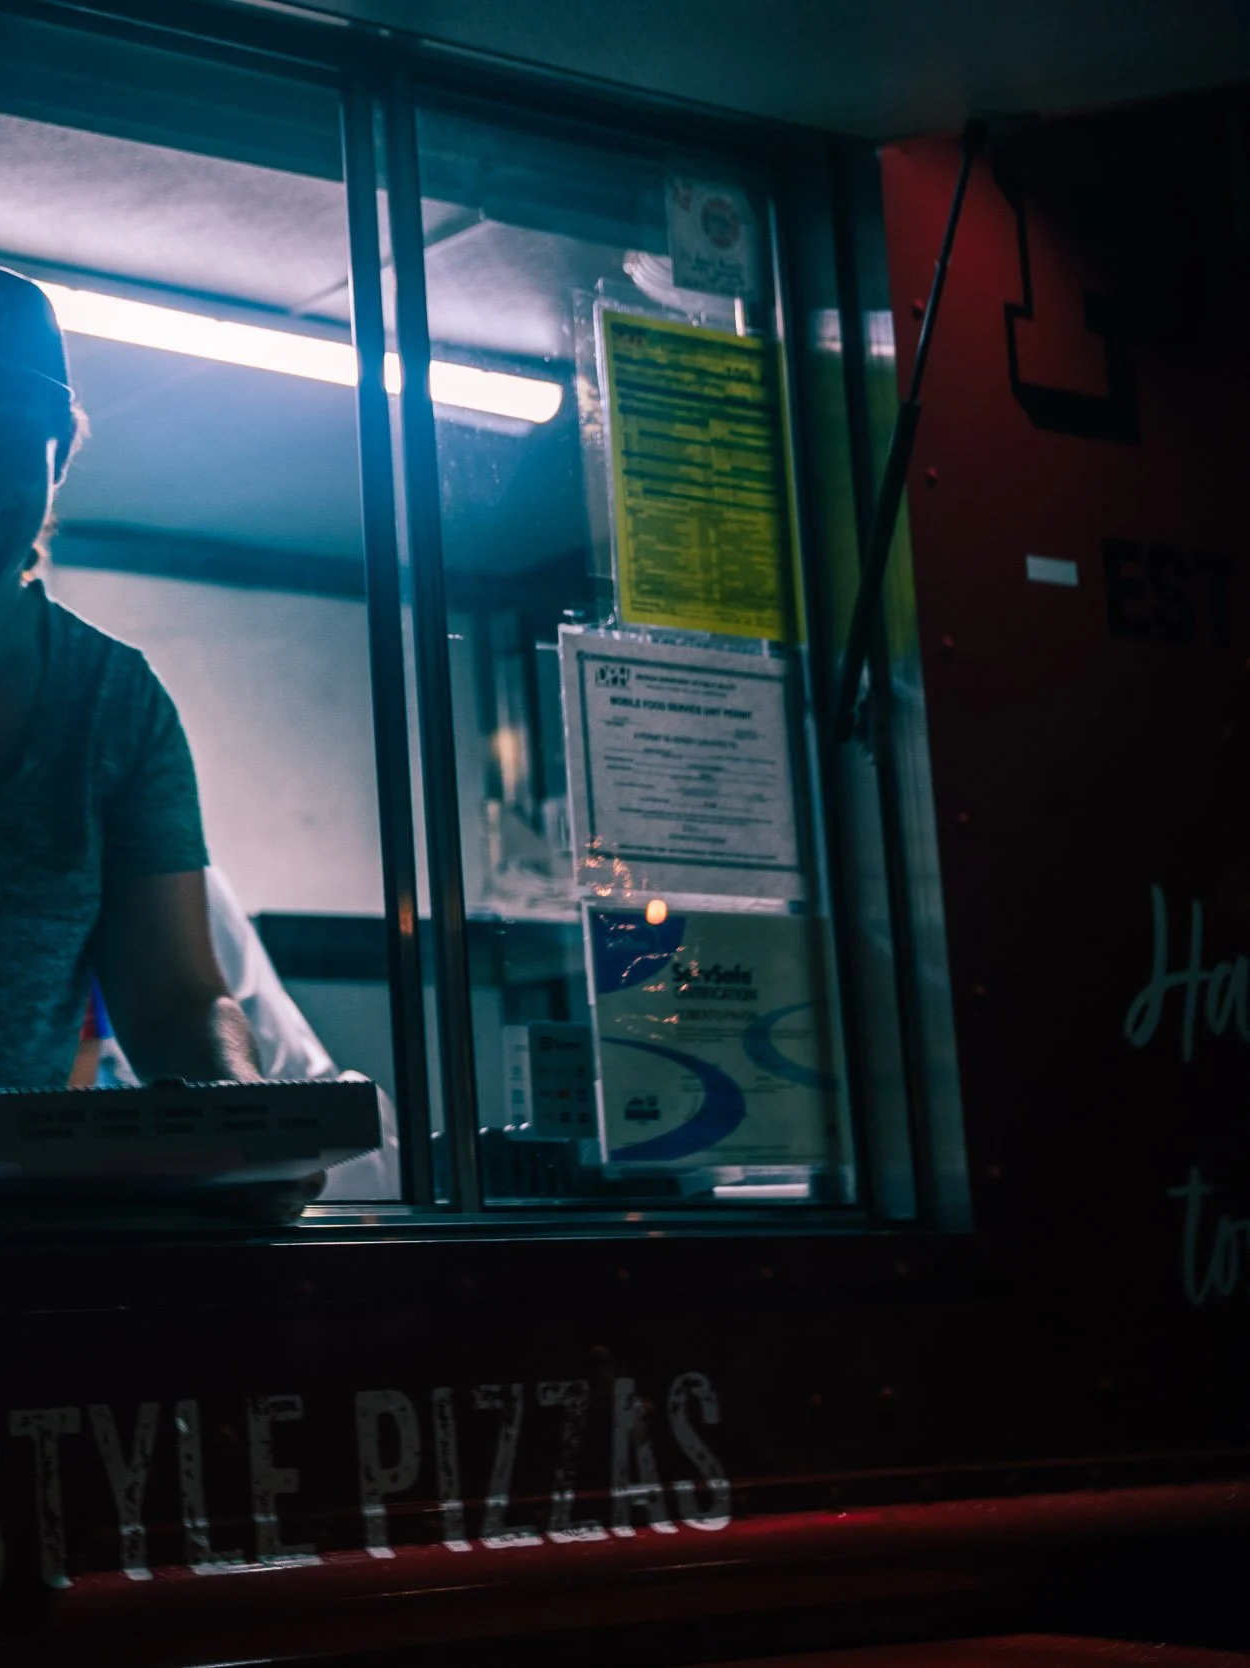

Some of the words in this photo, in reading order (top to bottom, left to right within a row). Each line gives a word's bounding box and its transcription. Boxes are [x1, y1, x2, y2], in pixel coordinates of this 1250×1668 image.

[610, 696, 640, 708] MOBILE
[643, 699, 665, 711] FOOD
[668, 702, 701, 715] SERVICE
[703, 705, 721, 717] UNIT
[723, 708, 753, 720] PERMIT
[354, 1369, 733, 1560] PIZZAS
